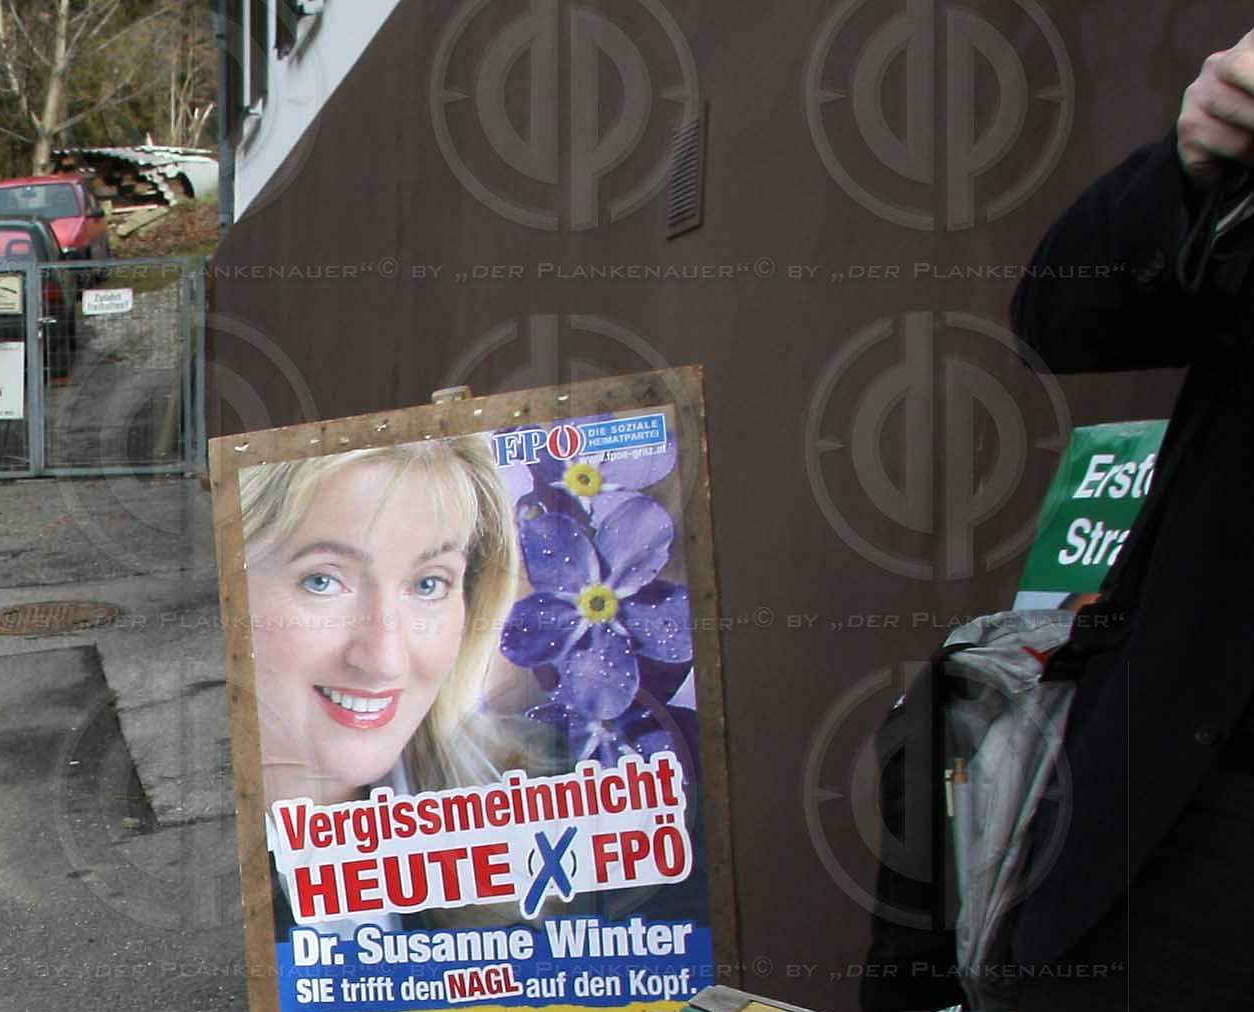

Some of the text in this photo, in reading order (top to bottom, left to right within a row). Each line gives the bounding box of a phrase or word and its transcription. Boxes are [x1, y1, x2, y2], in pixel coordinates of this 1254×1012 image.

[588, 431, 660, 447] HEIMATPARTEI
[610, 420, 659, 434] SOZIALE
[279, 757, 678, 855] Vergissmeinnicht
[294, 841, 516, 919] HEUTE
[591, 813, 688, 885] FPÖ
[292, 917, 693, 967] Dr. Susanne Winter
[296, 965, 698, 1004] SIE trifft den NAGL auf den Kopf.
